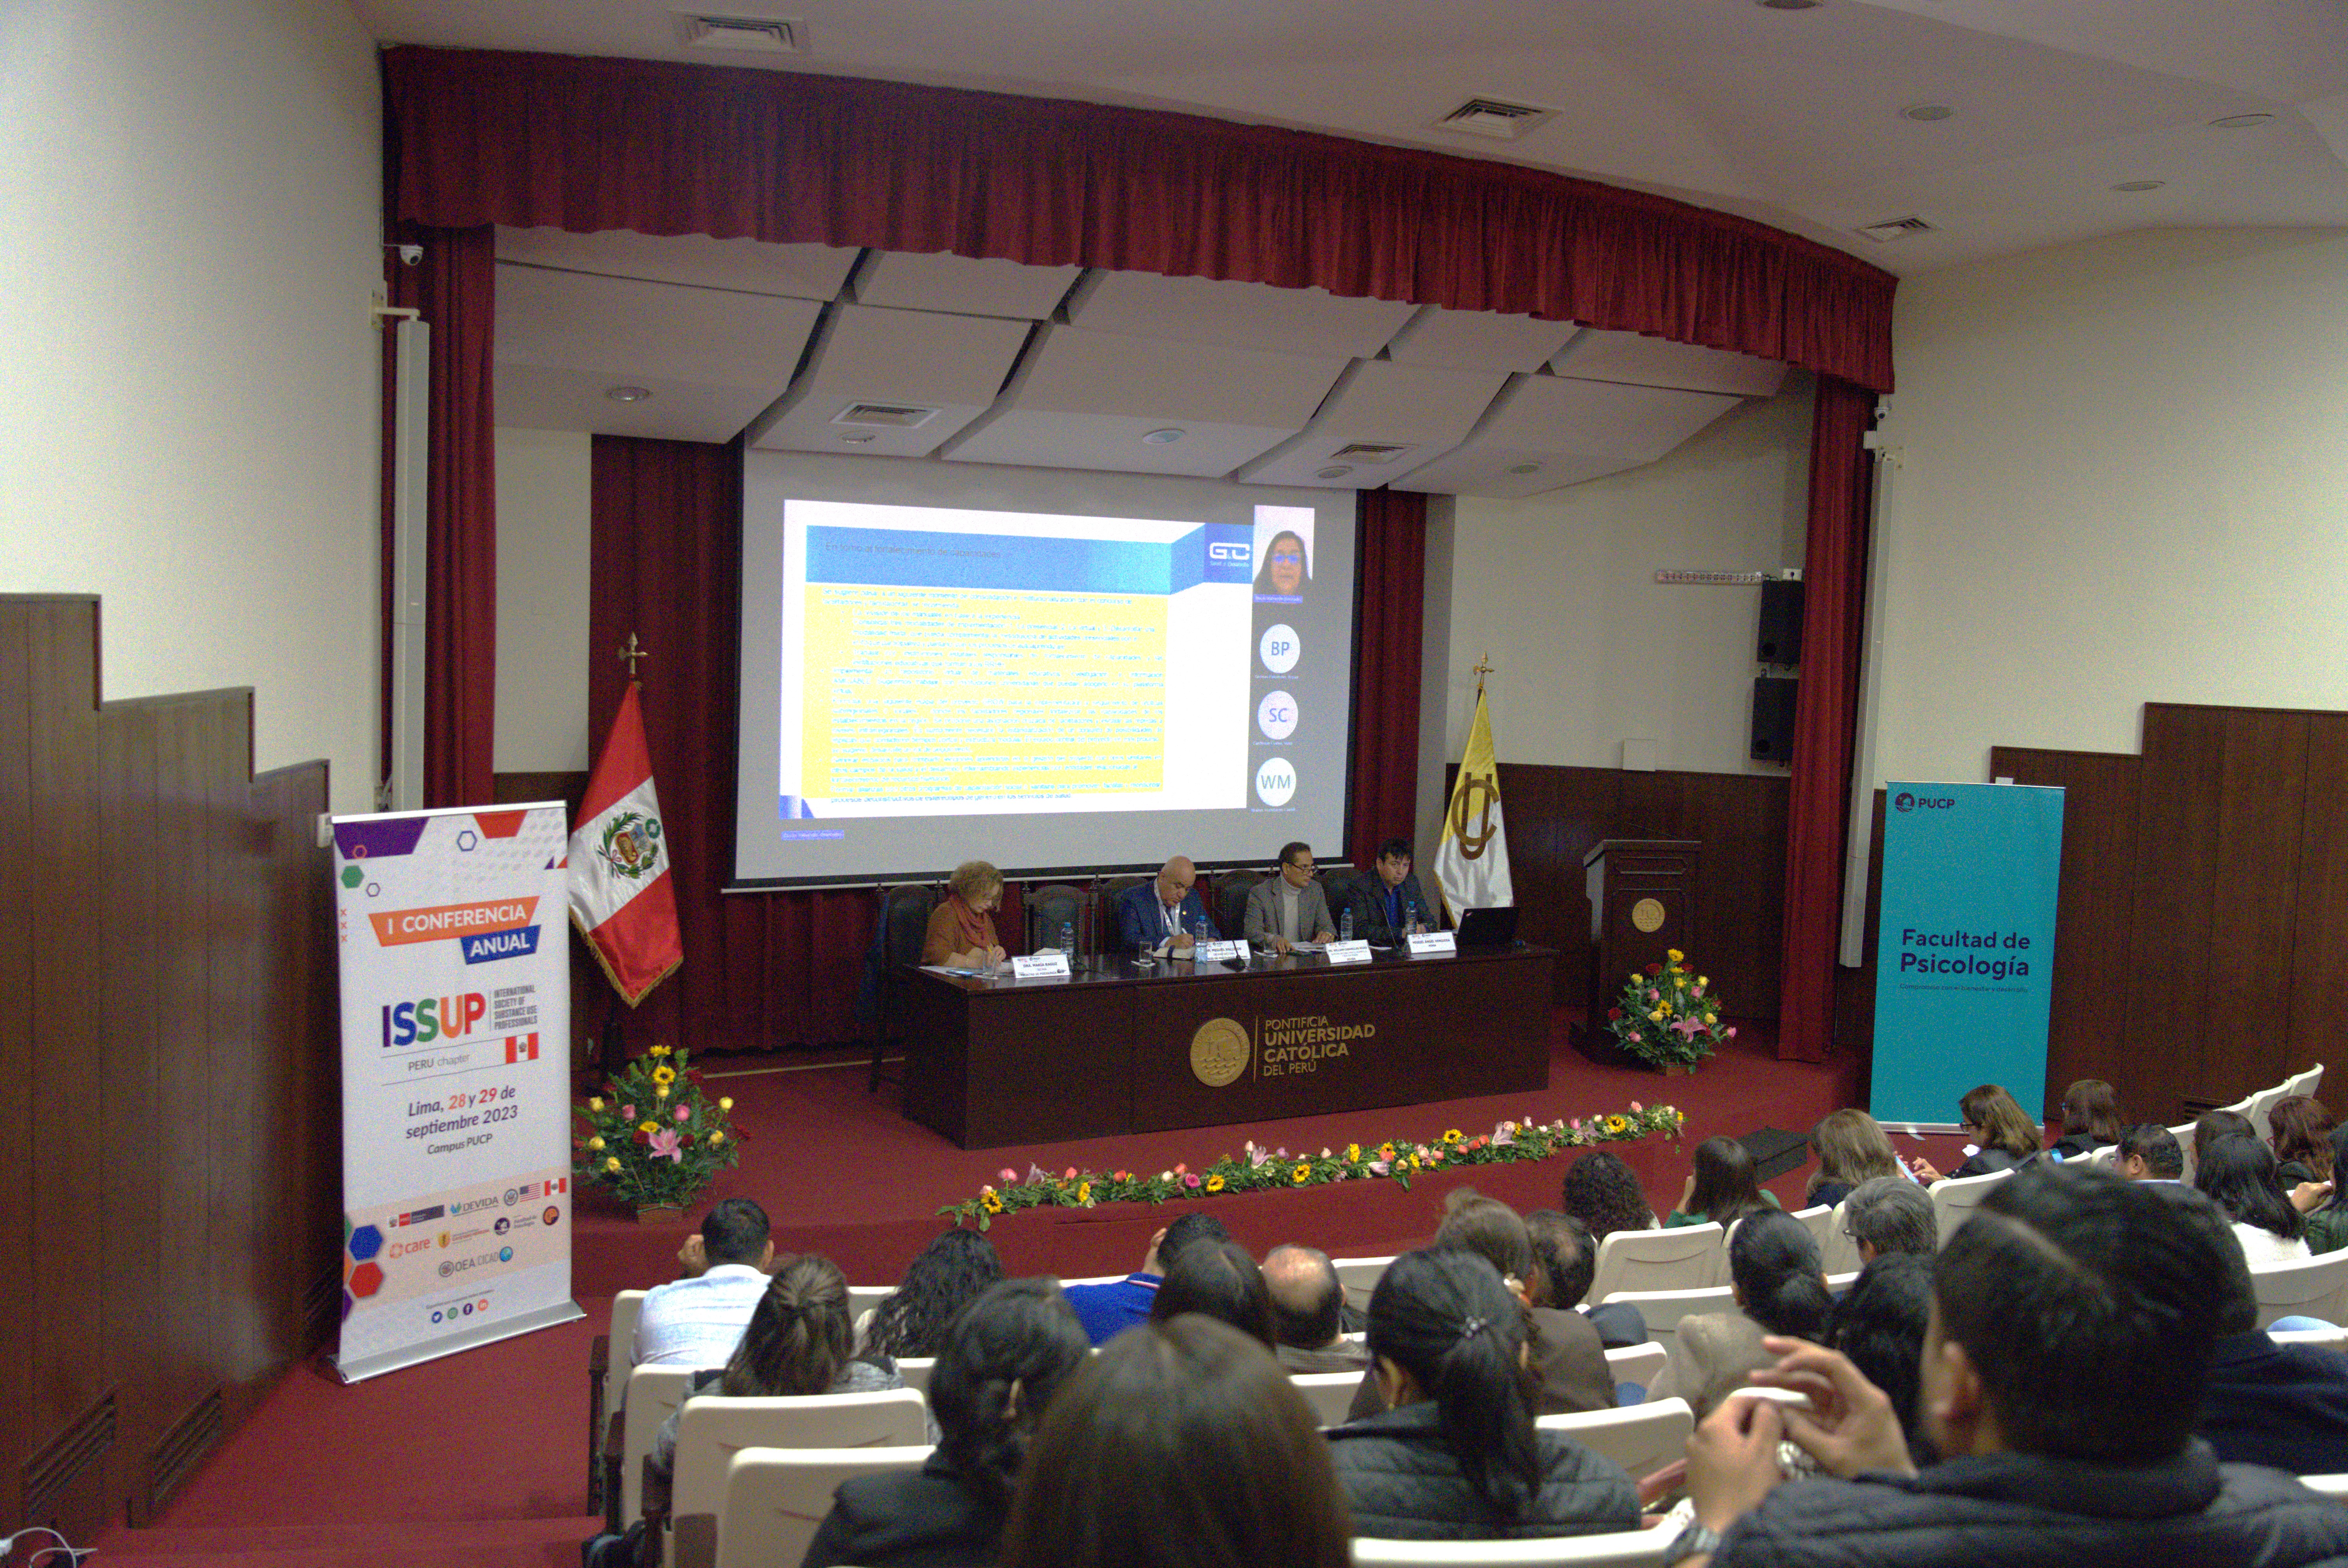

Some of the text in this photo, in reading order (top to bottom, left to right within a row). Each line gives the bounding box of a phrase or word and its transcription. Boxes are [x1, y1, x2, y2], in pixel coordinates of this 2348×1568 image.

[826, 542, 837, 551] En
[865, 544, 873, 553] al
[874, 544, 935, 555] fortalecimiento
[950, 549, 1001, 559] capacidades
[1271, 641, 1289, 656] BP
[1269, 707, 1288, 723] SC
[1261, 775, 1291, 789] WM
[1918, 798, 1955, 809] PUCP
[388, 904, 527, 934] I CONFERENCIA
[470, 933, 530, 957] ANUAL
[1902, 928, 2030, 950] Facultad de
[1900, 952, 2029, 981] Psicología
[494, 985, 536, 998] INTERNATIONAL
[1900, 983, 1940, 991] Compromiso
[494, 996, 525, 1009] SOCIETY OF
[382, 992, 486, 1048] ISSUP
[494, 1005, 537, 1019] SUBSTANCE USE
[494, 1015, 537, 1030] PROFESSIONALS
[1265, 1015, 1329, 1031] PONTIFICIA
[1265, 1024, 1376, 1046] UNIVERSIDAD
[1264, 1042, 1349, 1063] CATÓLICA
[408, 1054, 471, 1071] PERU chapter
[1263, 1059, 1316, 1077] DEL PERÚ
[408, 1085, 516, 1117] Lima, 28 y 29 de
[406, 1105, 518, 1139] septiembre 2023
[427, 1133, 493, 1155] Campus PUCP
[463, 1196, 499, 1212] DEVIDA
[405, 1238, 431, 1254] care
[456, 1252, 499, 1272] OEA CICAD
